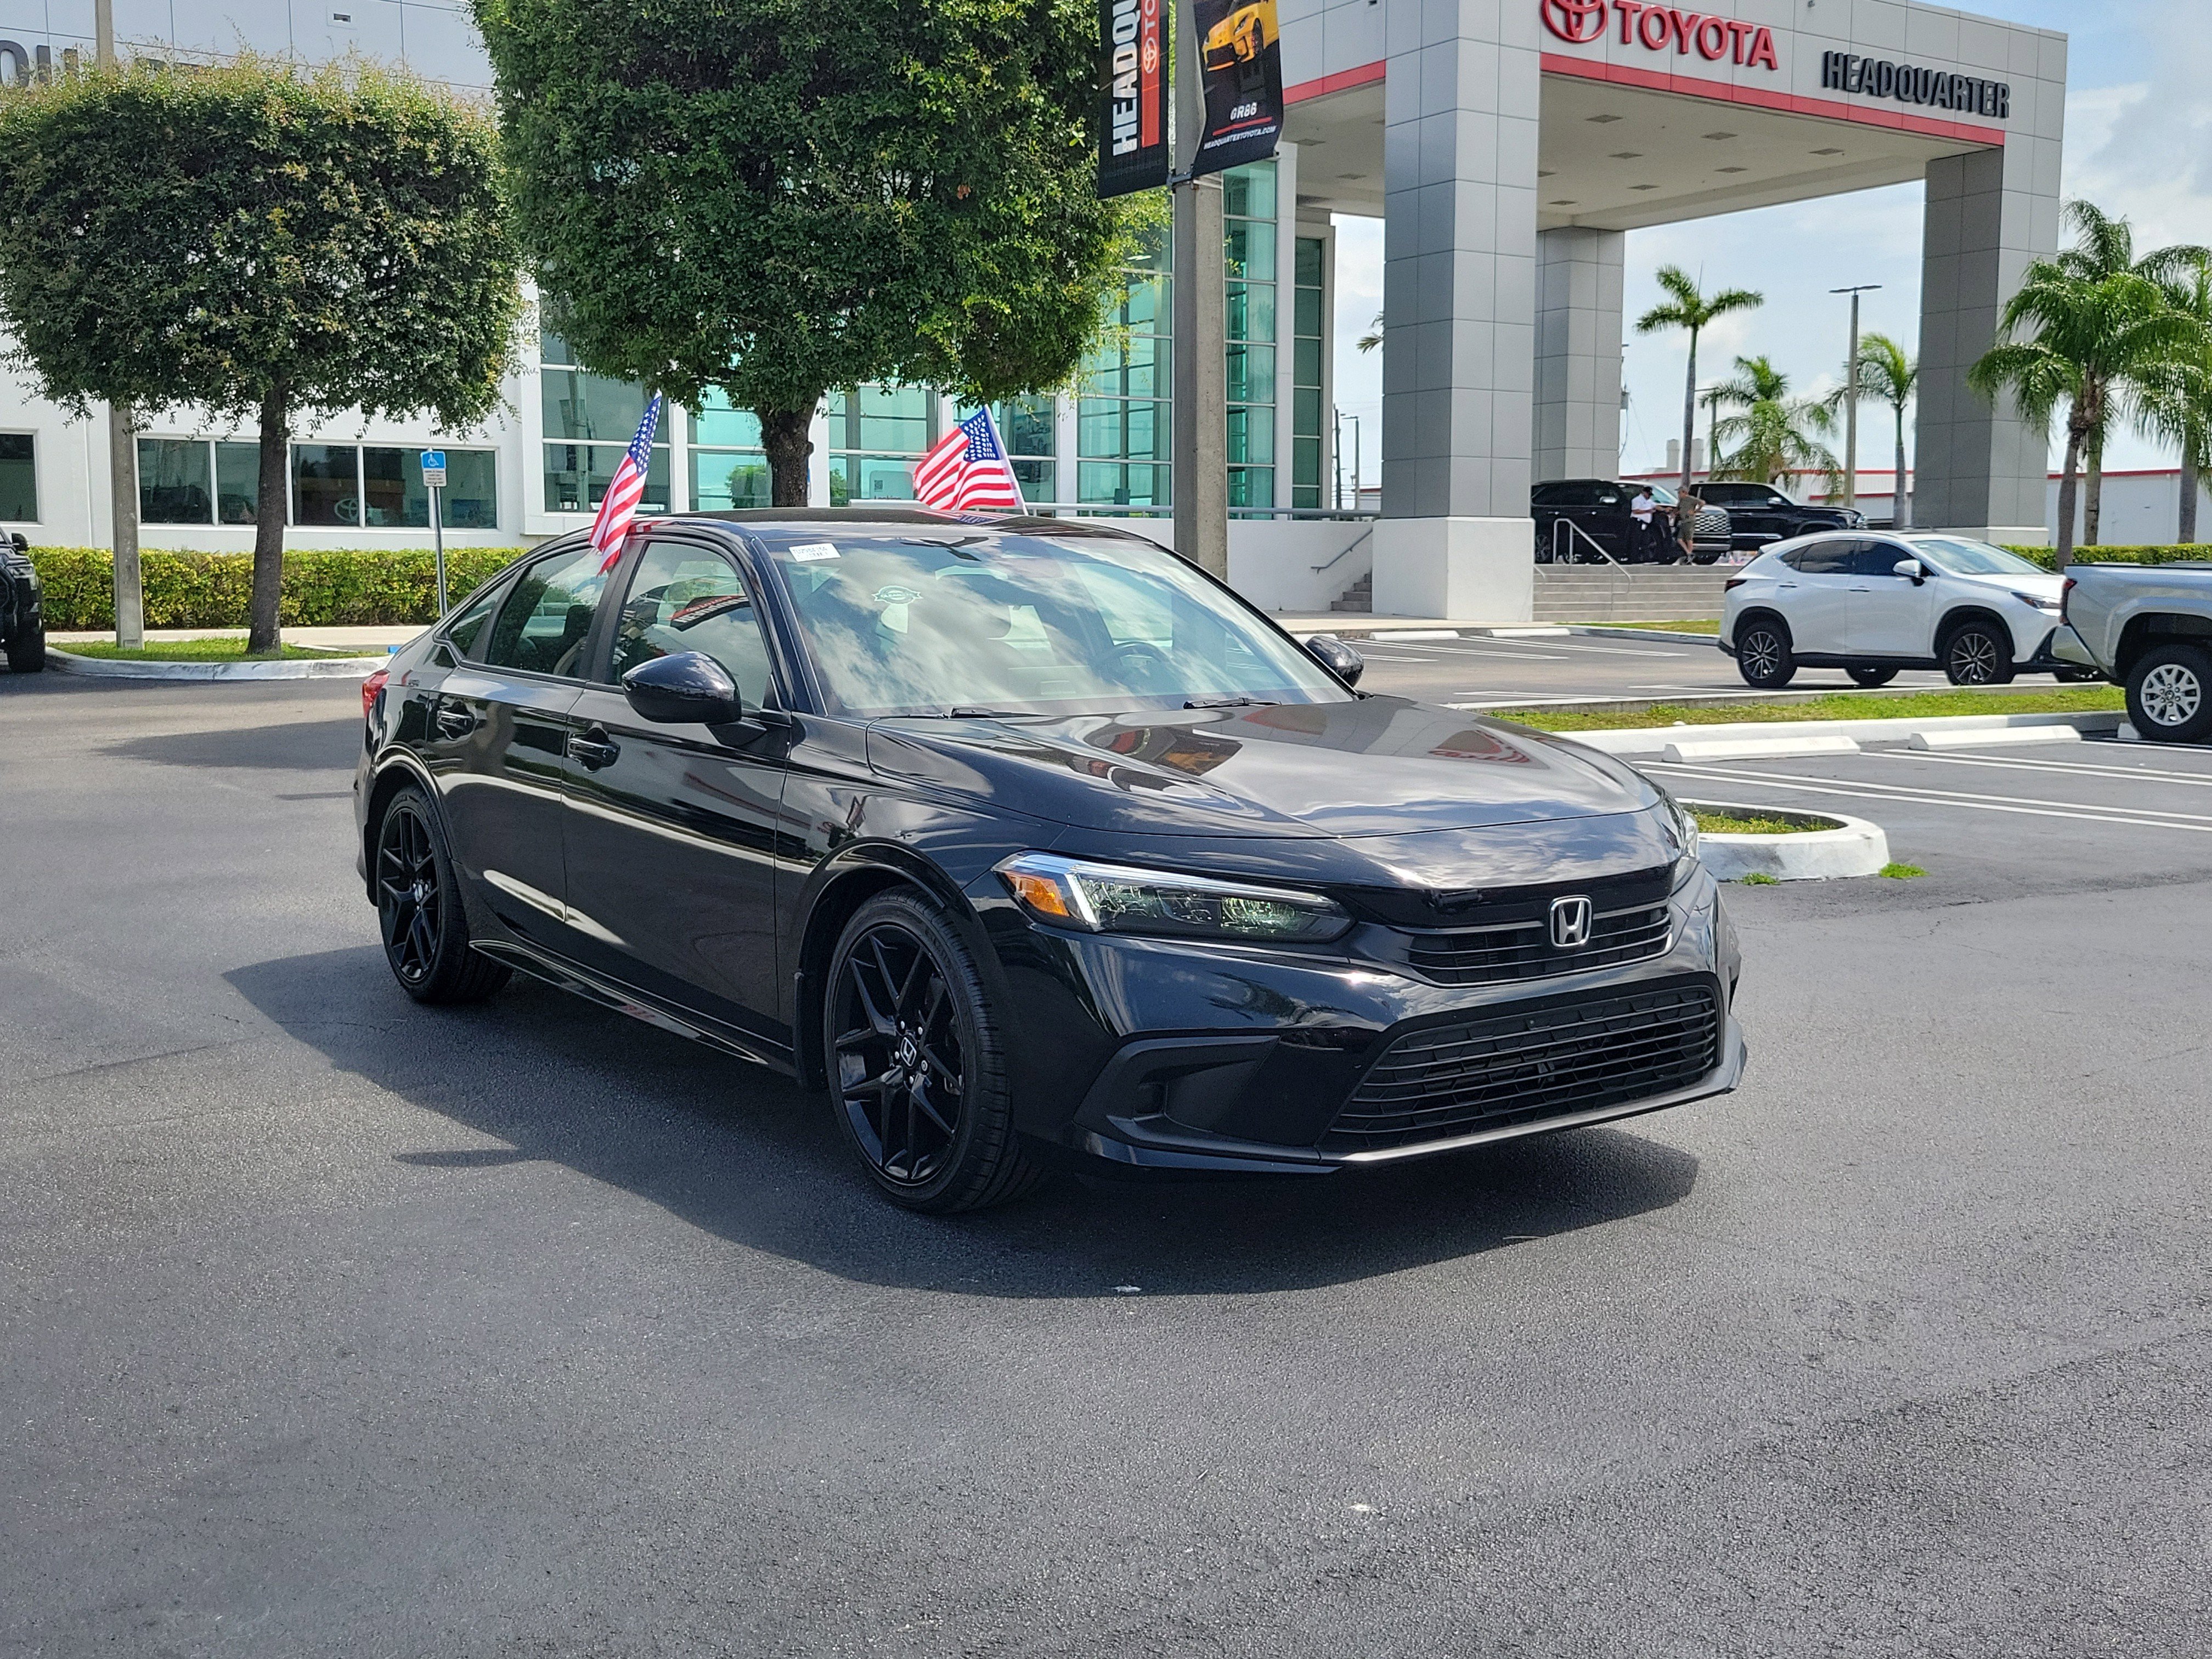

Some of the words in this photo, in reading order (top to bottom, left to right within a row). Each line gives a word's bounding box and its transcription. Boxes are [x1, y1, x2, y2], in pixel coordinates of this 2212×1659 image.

[1613, 0, 1778, 70] TOYOTA
[1230, 101, 1257, 121] GR86
[1821, 51, 2010, 119] HEADQUARTER
